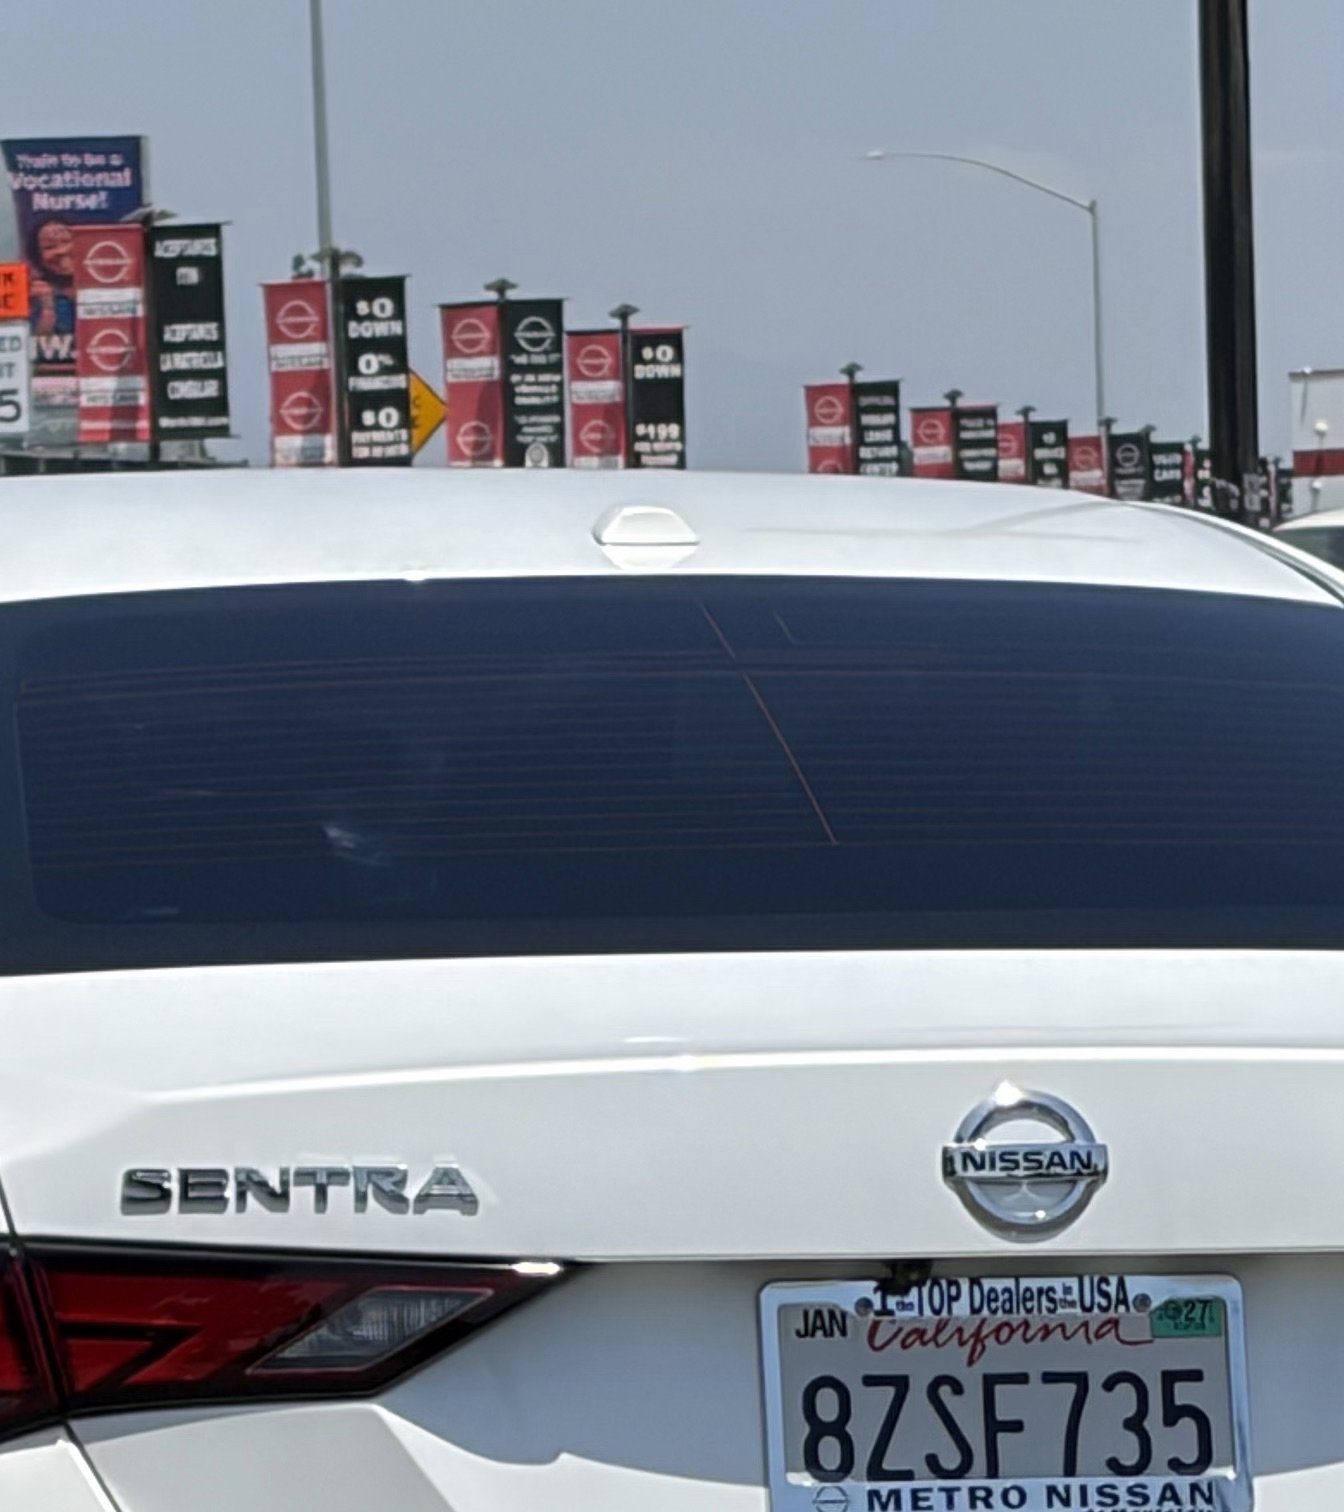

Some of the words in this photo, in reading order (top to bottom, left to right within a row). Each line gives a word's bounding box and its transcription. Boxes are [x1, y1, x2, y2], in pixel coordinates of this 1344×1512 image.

[8, 168, 132, 191] Vocational
[348, 320, 403, 339] DOWN
[633, 364, 682, 380] DOWN
[960, 1150, 1094, 1172] NISSAN
[120, 1163, 480, 1217] SENTRA
[913, 1277, 962, 1317] TOP
[968, 1276, 1059, 1316] Dealers
[1077, 1275, 1132, 1314] USA
[1184, 1299, 1212, 1323] 27
[795, 1308, 848, 1339] JAN
[867, 1317, 1155, 1368] California
[801, 1369, 1215, 1484] 8ZSF735
[865, 1484, 1028, 1512] METRO
[1045, 1481, 1214, 1508] NISSAN
